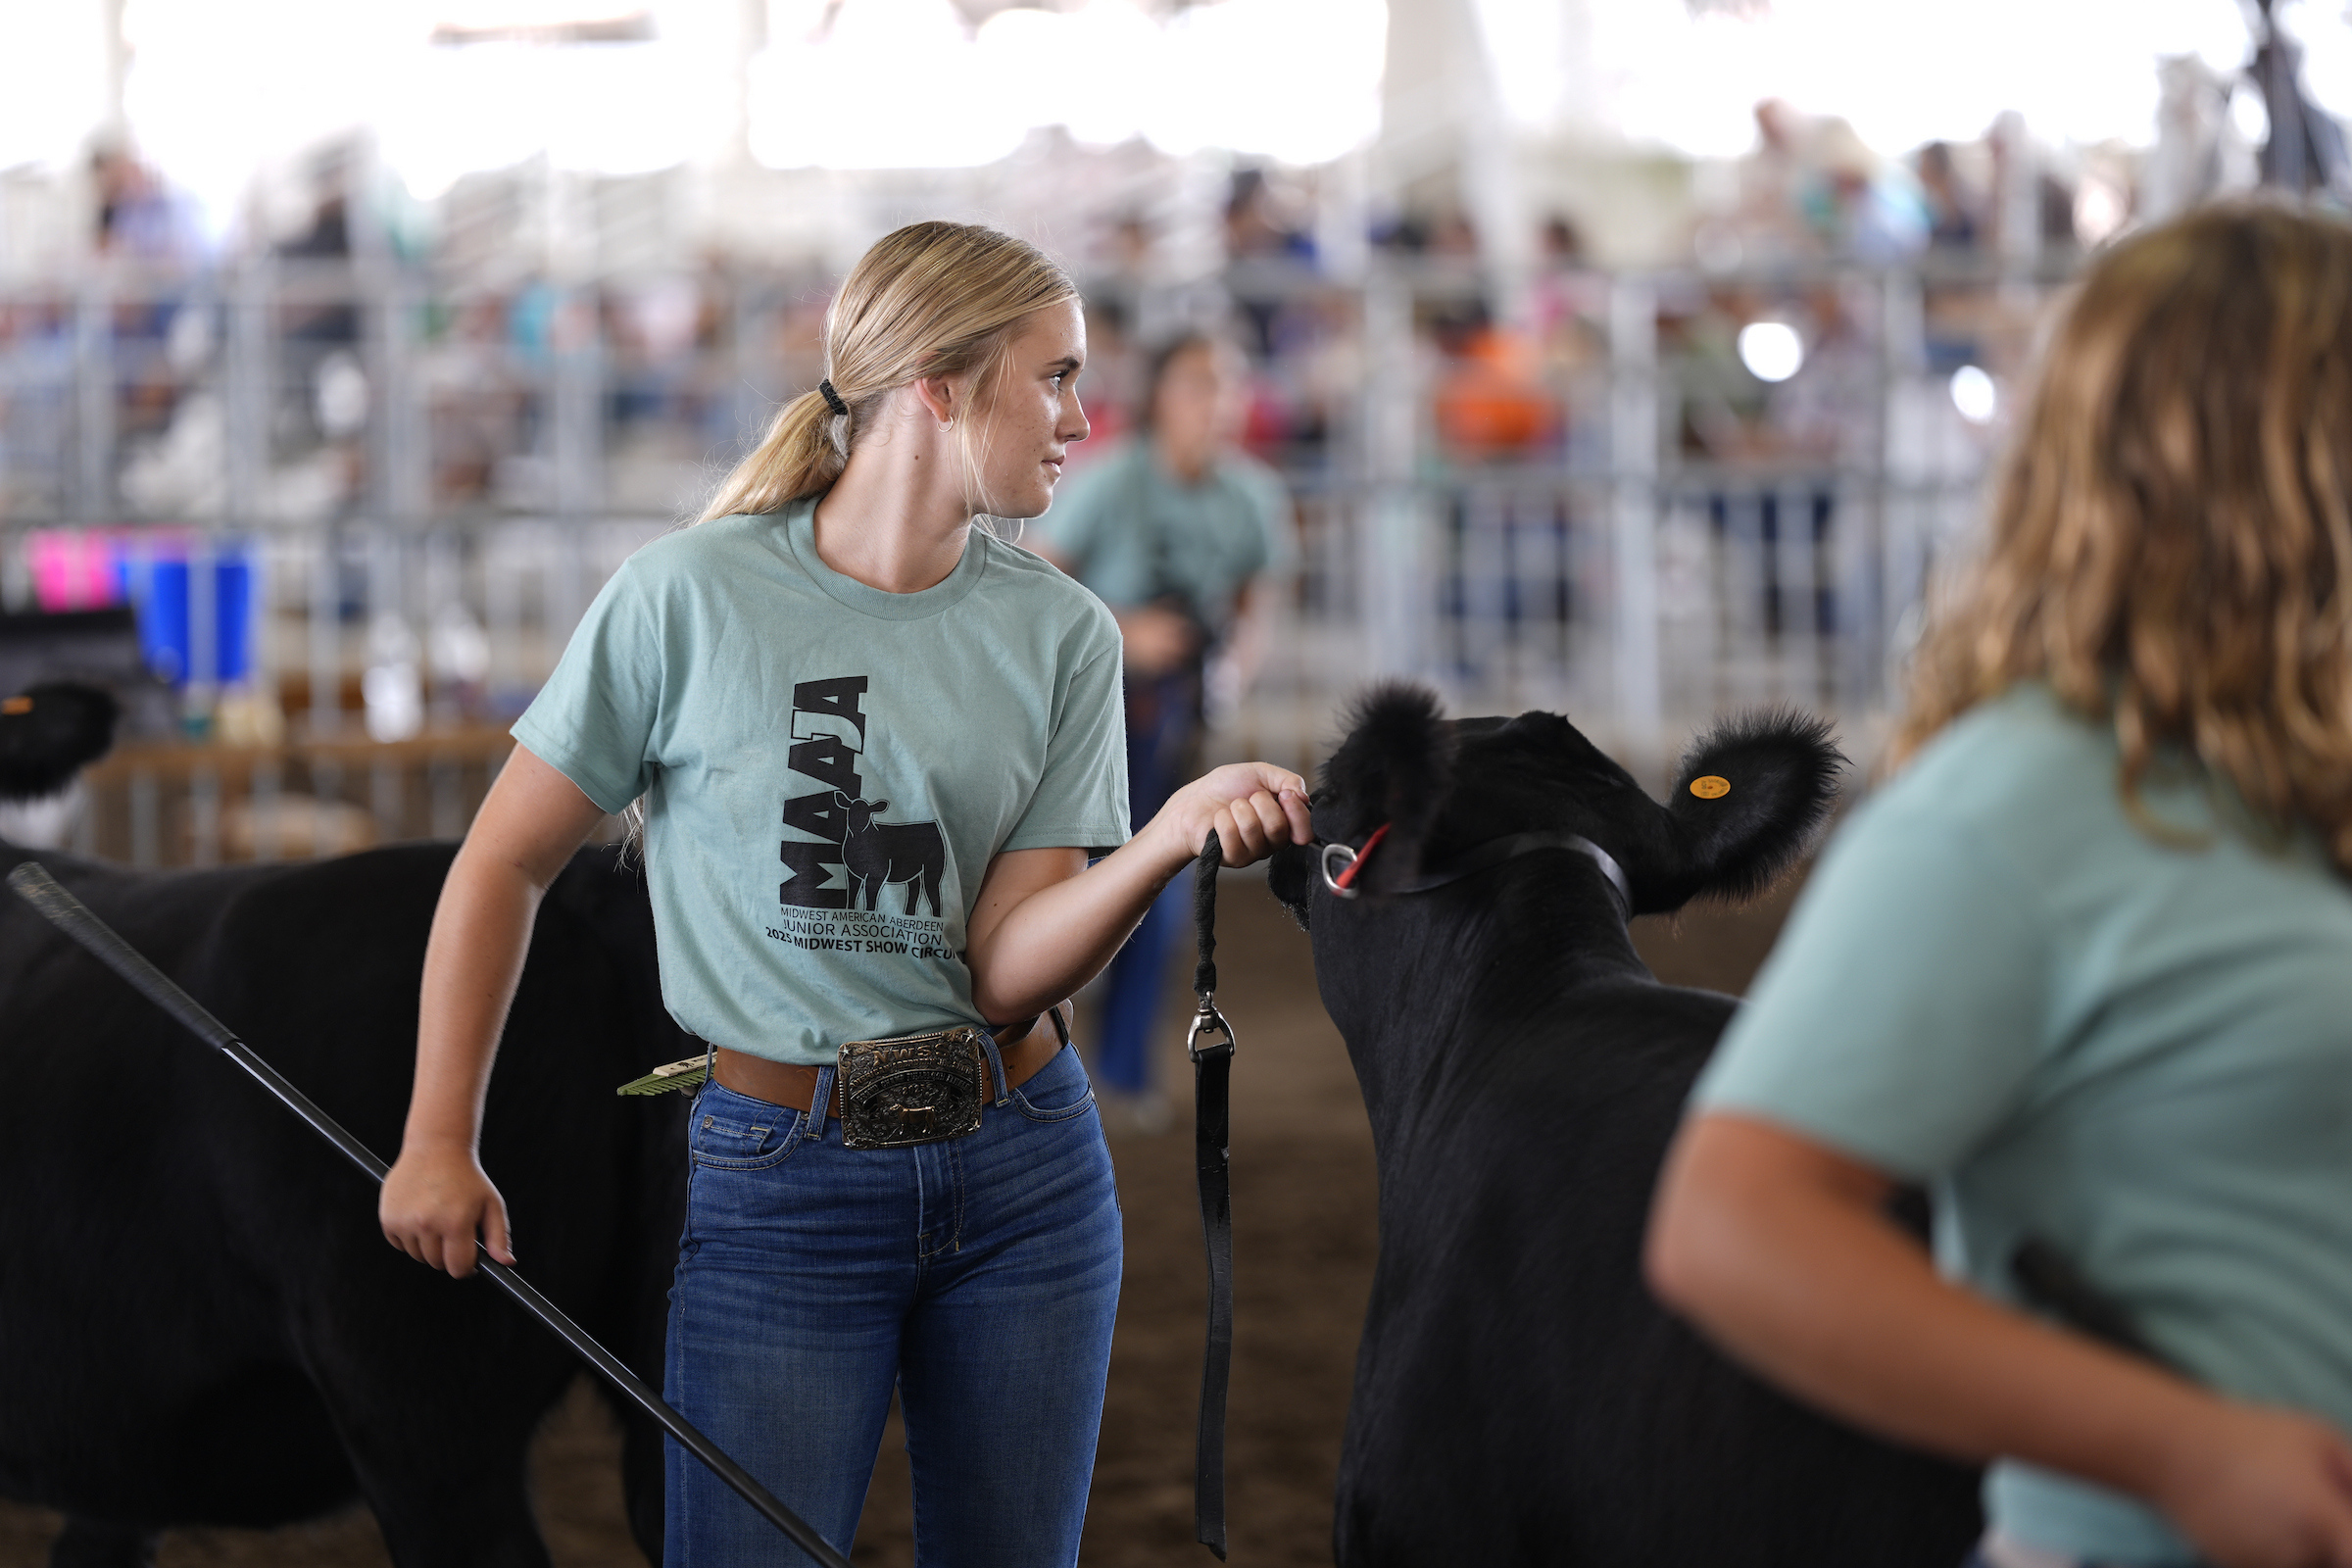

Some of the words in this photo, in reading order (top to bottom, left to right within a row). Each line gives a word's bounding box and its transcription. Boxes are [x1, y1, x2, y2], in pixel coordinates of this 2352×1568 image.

[780, 675, 867, 909] MAAJA
[781, 906, 829, 921] MIDWEST
[831, 911, 886, 923] AMERICAN
[889, 916, 944, 932] ABERDEEN
[765, 926, 792, 944] 2025
[794, 935, 862, 953] MIDWEST
[865, 941, 907, 955] SHOW
[911, 947, 956, 959] CIRCUI
[840, 923, 942, 946] ASSOCIATION
[871, 1043, 950, 1067] NWSS
